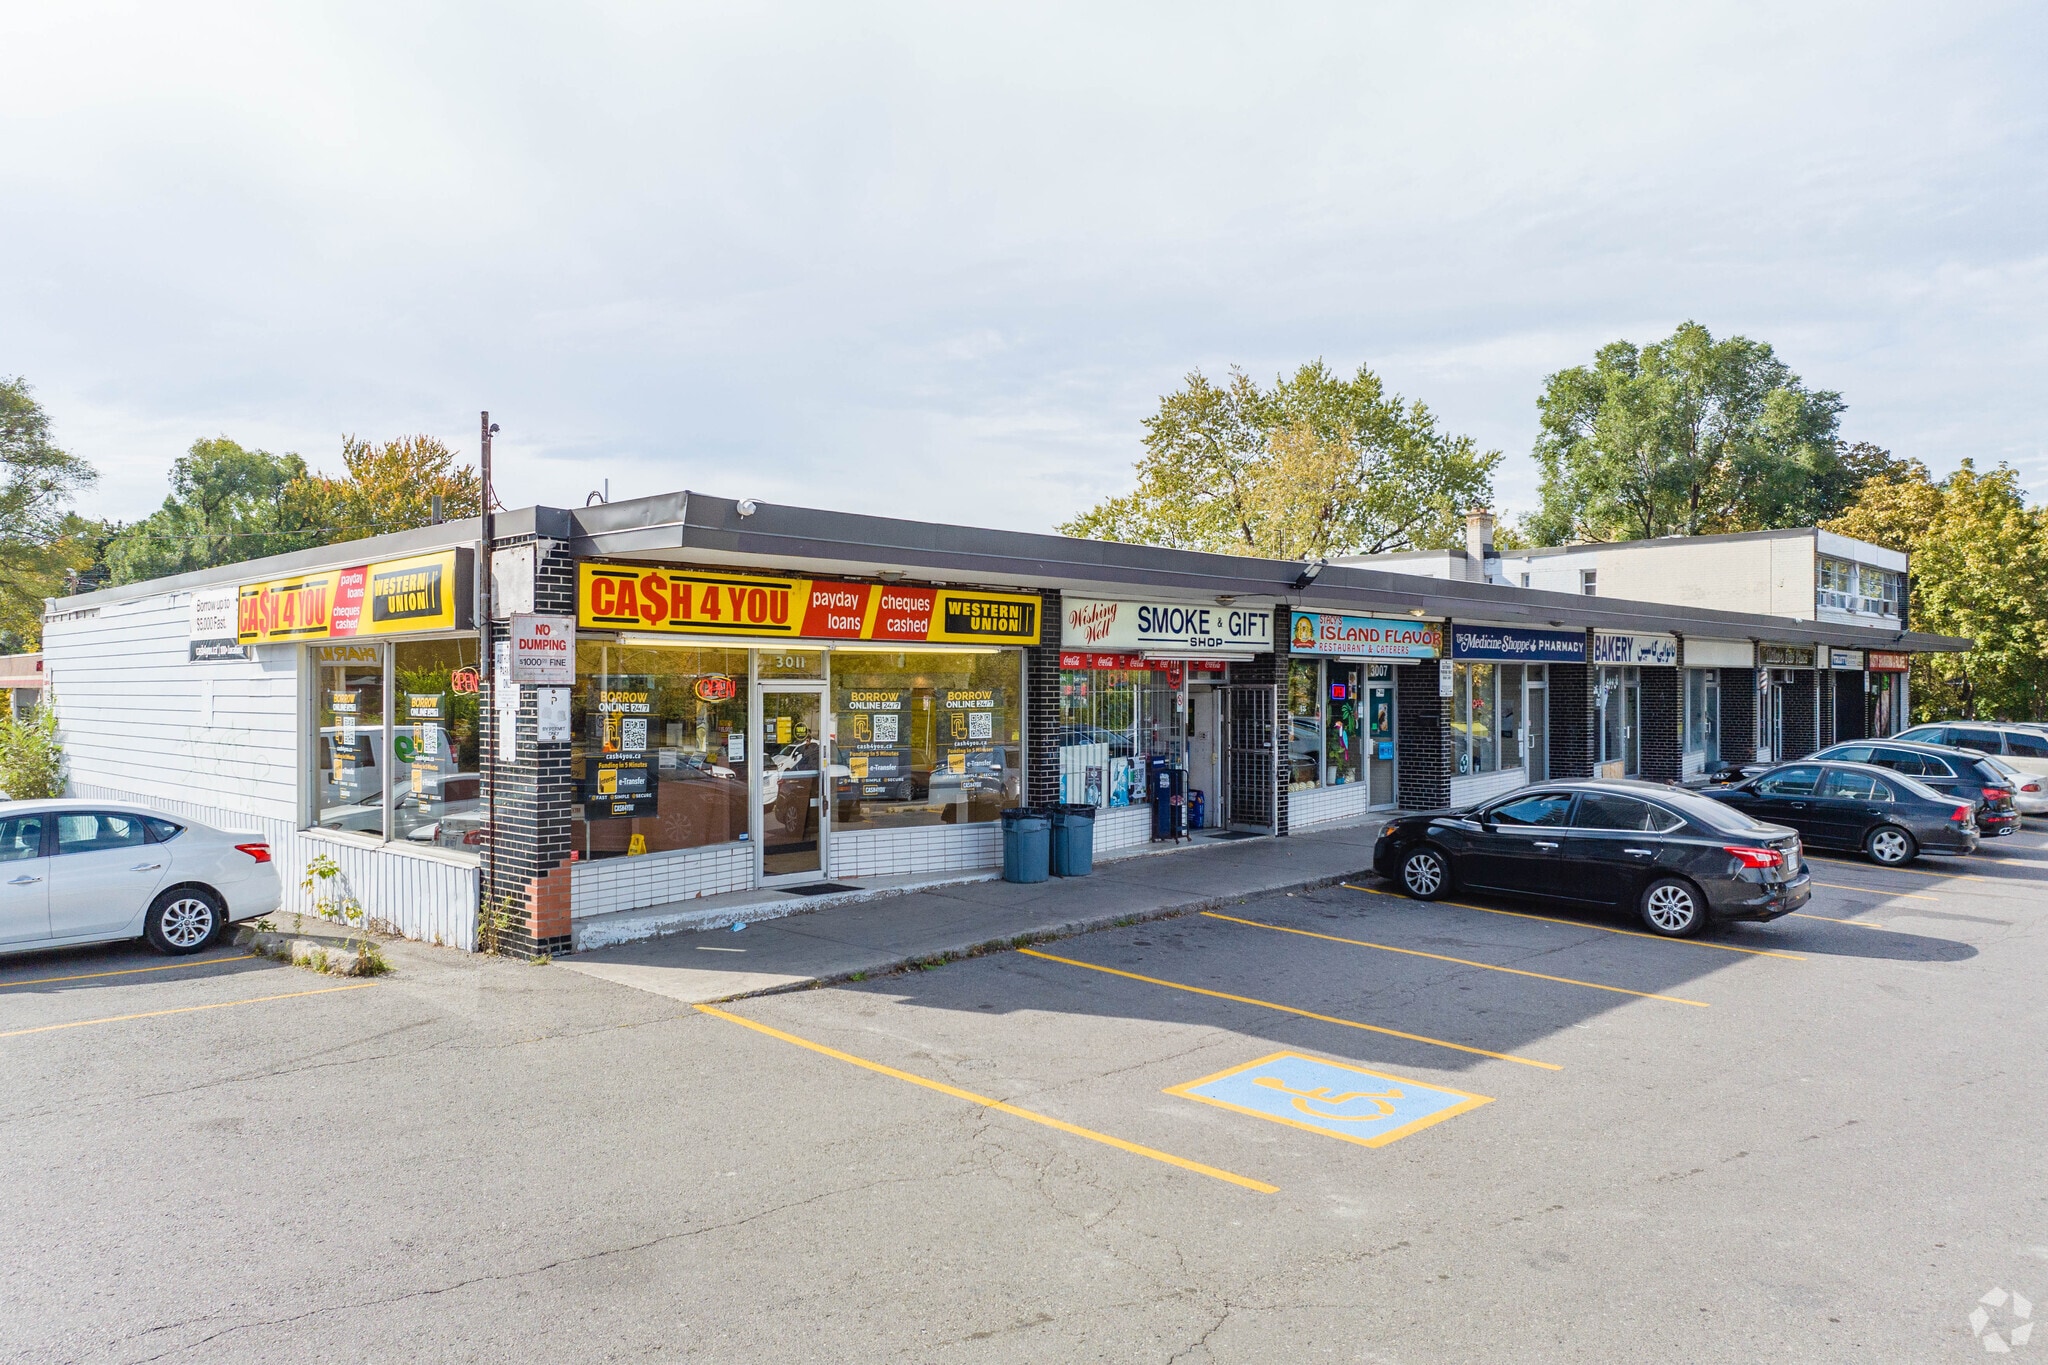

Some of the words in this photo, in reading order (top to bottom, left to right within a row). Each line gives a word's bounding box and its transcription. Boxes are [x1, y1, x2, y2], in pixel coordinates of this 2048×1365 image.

[340, 573, 363, 586] payday
[374, 572, 426, 597] WESTERN
[347, 588, 364, 598] loans
[591, 572, 692, 625] CA$H
[700, 586, 721, 620] 4
[728, 587, 789, 624] YOU
[388, 591, 426, 613] UNION
[812, 591, 859, 610] payday
[881, 595, 930, 613] cheques
[240, 587, 279, 638] CA$H
[283, 593, 295, 627] 4
[298, 588, 326, 627] YOU
[333, 606, 360, 617] cheques
[948, 601, 1019, 618] WESTERN
[828, 613, 861, 631] loans
[1069, 603, 1118, 629] Wishing
[1138, 606, 1210, 635] SMOKE
[1217, 617, 1223, 628] &
[1228, 611, 1269, 637] GIFT
[1319, 615, 1342, 625] STACY'S
[335, 618, 359, 629] cashed
[535, 624, 551, 635] NO
[887, 617, 928, 633] cashed
[970, 616, 1019, 632] UNION
[1084, 619, 1111, 644] Well
[1320, 626, 1380, 642] ISLAND
[1385, 629, 1441, 645] FLAVOR
[519, 639, 567, 651] DUMPING
[1190, 637, 1223, 647] SHOP
[1319, 642, 1365, 653] RESTAURANT
[1376, 645, 1409, 654] CATERERS
[1461, 633, 1502, 652] Medicine
[1501, 634, 1530, 653] Shoppe
[1538, 640, 1584, 653] PHARMACY
[1594, 635, 1633, 662] BAKERY
[550, 658, 567, 666] FINE
[776, 656, 805, 668] 3011
[1370, 665, 1388, 677] 3007
[452, 670, 479, 692] OPEN
[700, 679, 736, 698] OPEN
[333, 694, 356, 703] BORROW
[411, 697, 438, 707] BORROW
[600, 691, 648, 703] BORROW
[851, 692, 899, 702] BORROW
[947, 691, 993, 701] BORROW
[599, 703, 630, 712] ONLINE
[631, 704, 649, 712] 24/7
[849, 702, 881, 710] ONLINE
[882, 702, 901, 710] 24/7
[976, 700, 994, 708] 24/7
[618, 777, 645, 785] e-Transfer
